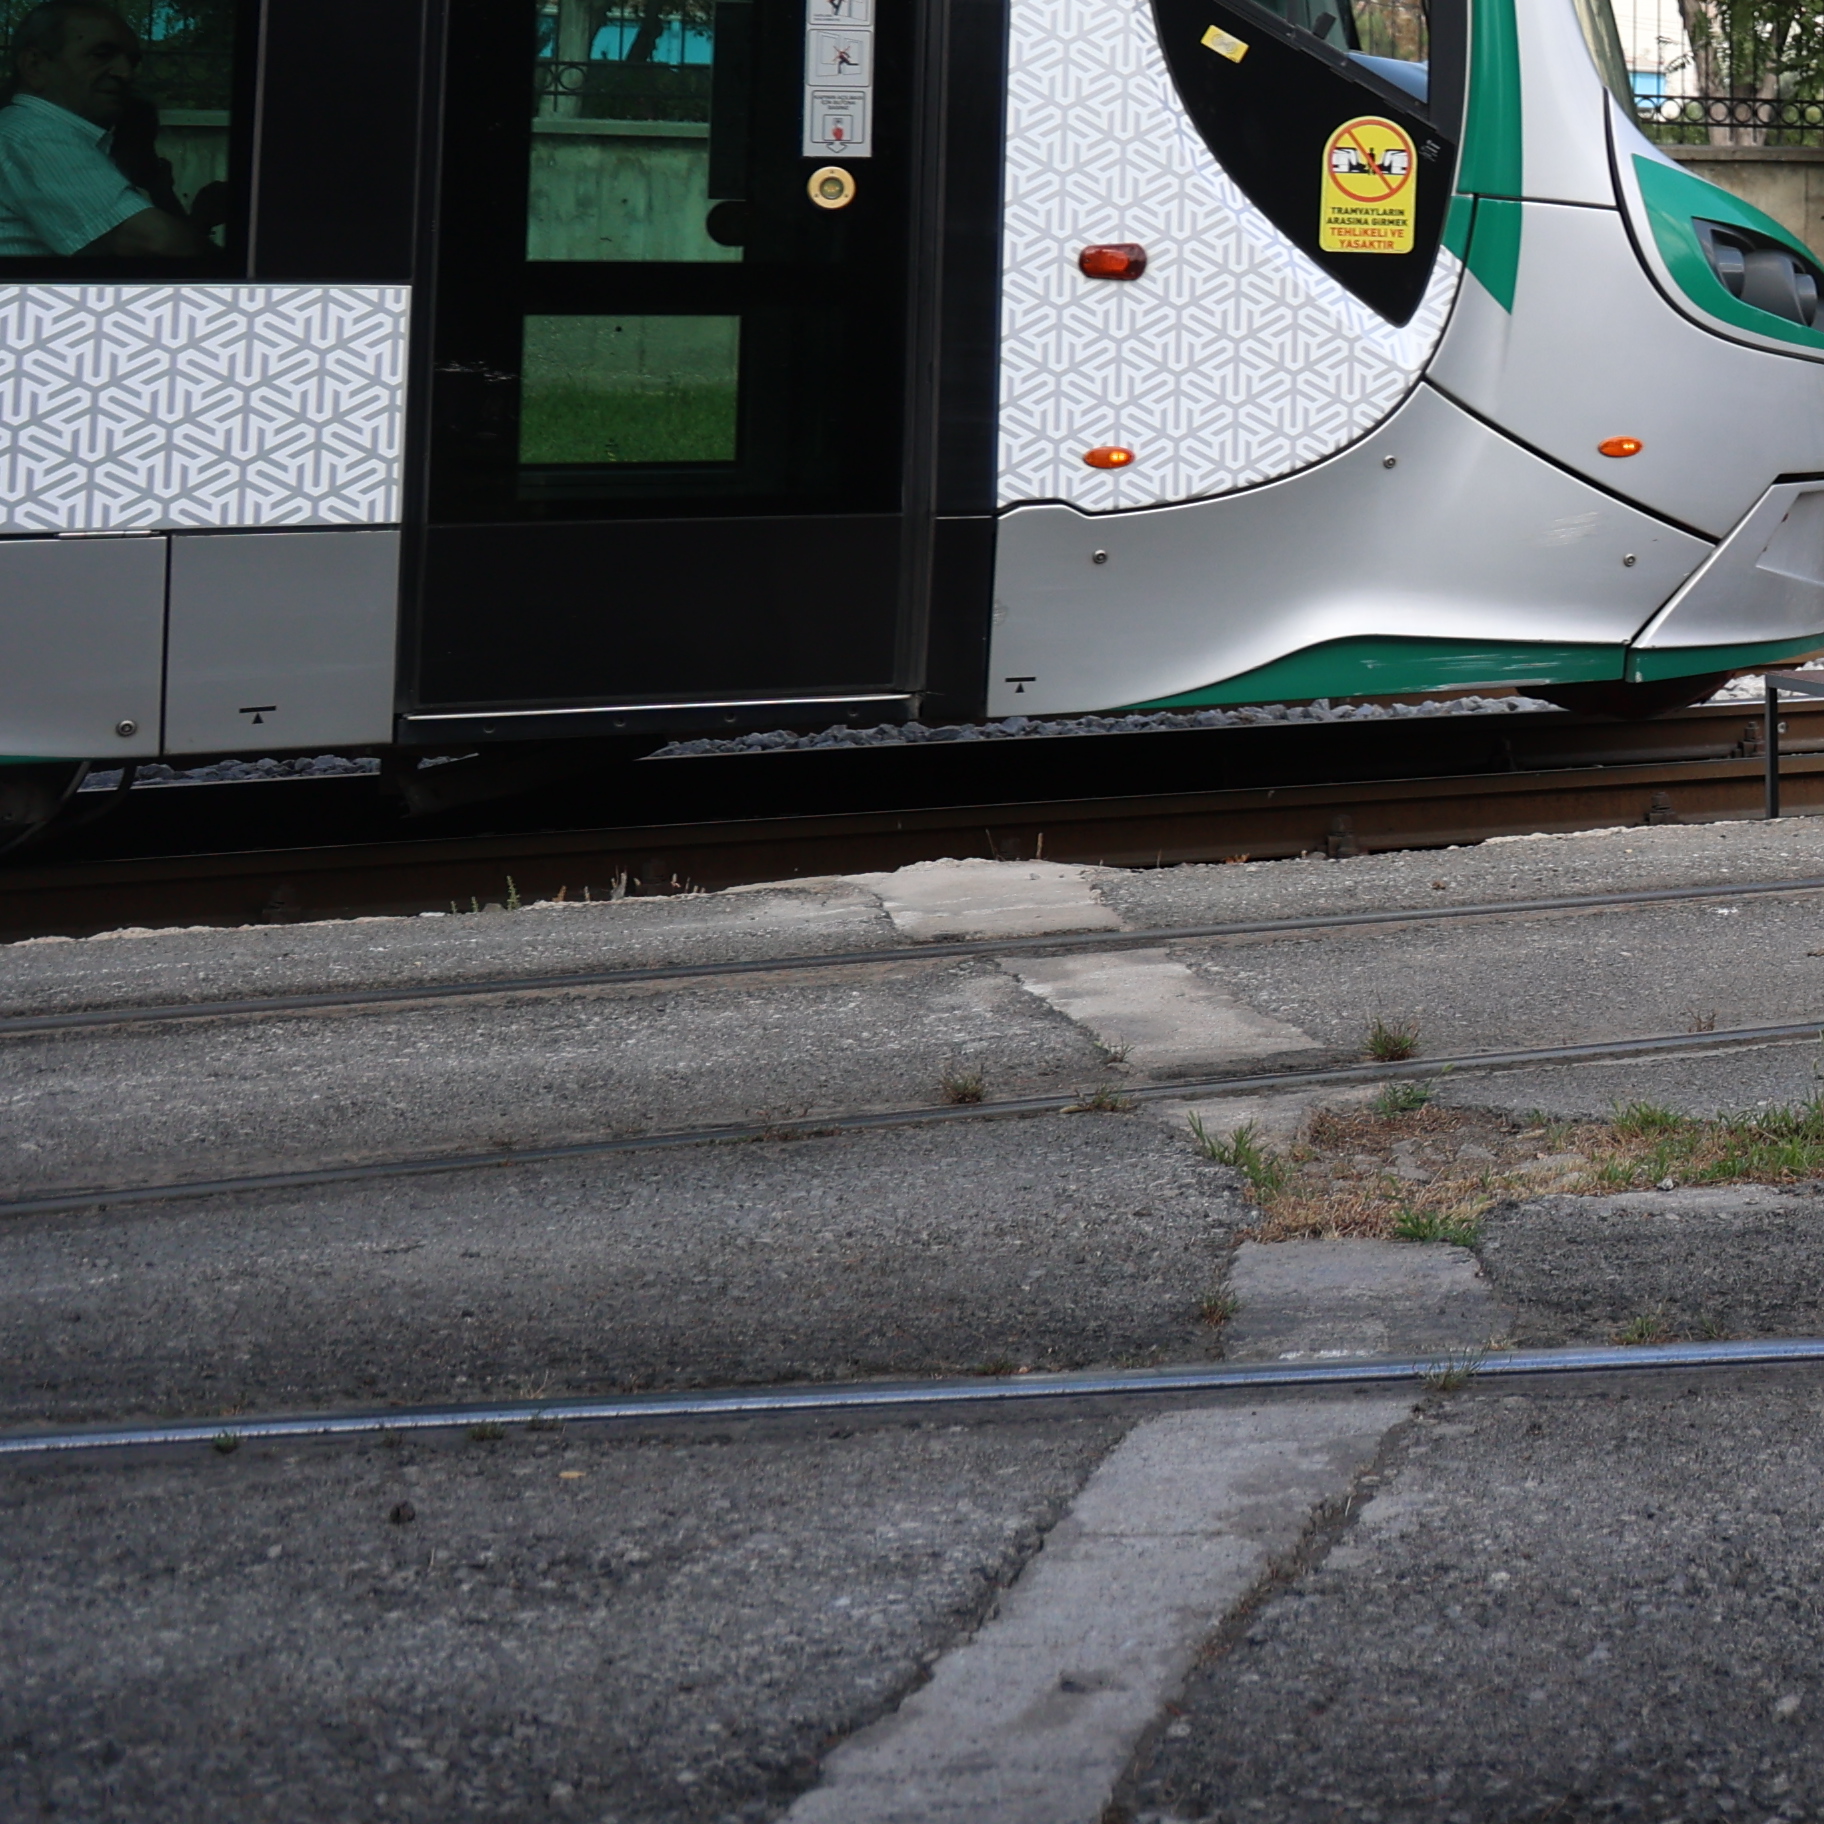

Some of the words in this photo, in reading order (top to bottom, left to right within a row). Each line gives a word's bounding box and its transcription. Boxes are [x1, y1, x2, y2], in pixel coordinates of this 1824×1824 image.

[1330, 207, 1405, 216] TRAMVAYLARIN
[1326, 217, 1370, 226] ARASINA
[1390, 228, 1405, 238] VE
[1339, 239, 1394, 250] YASAKTIR
